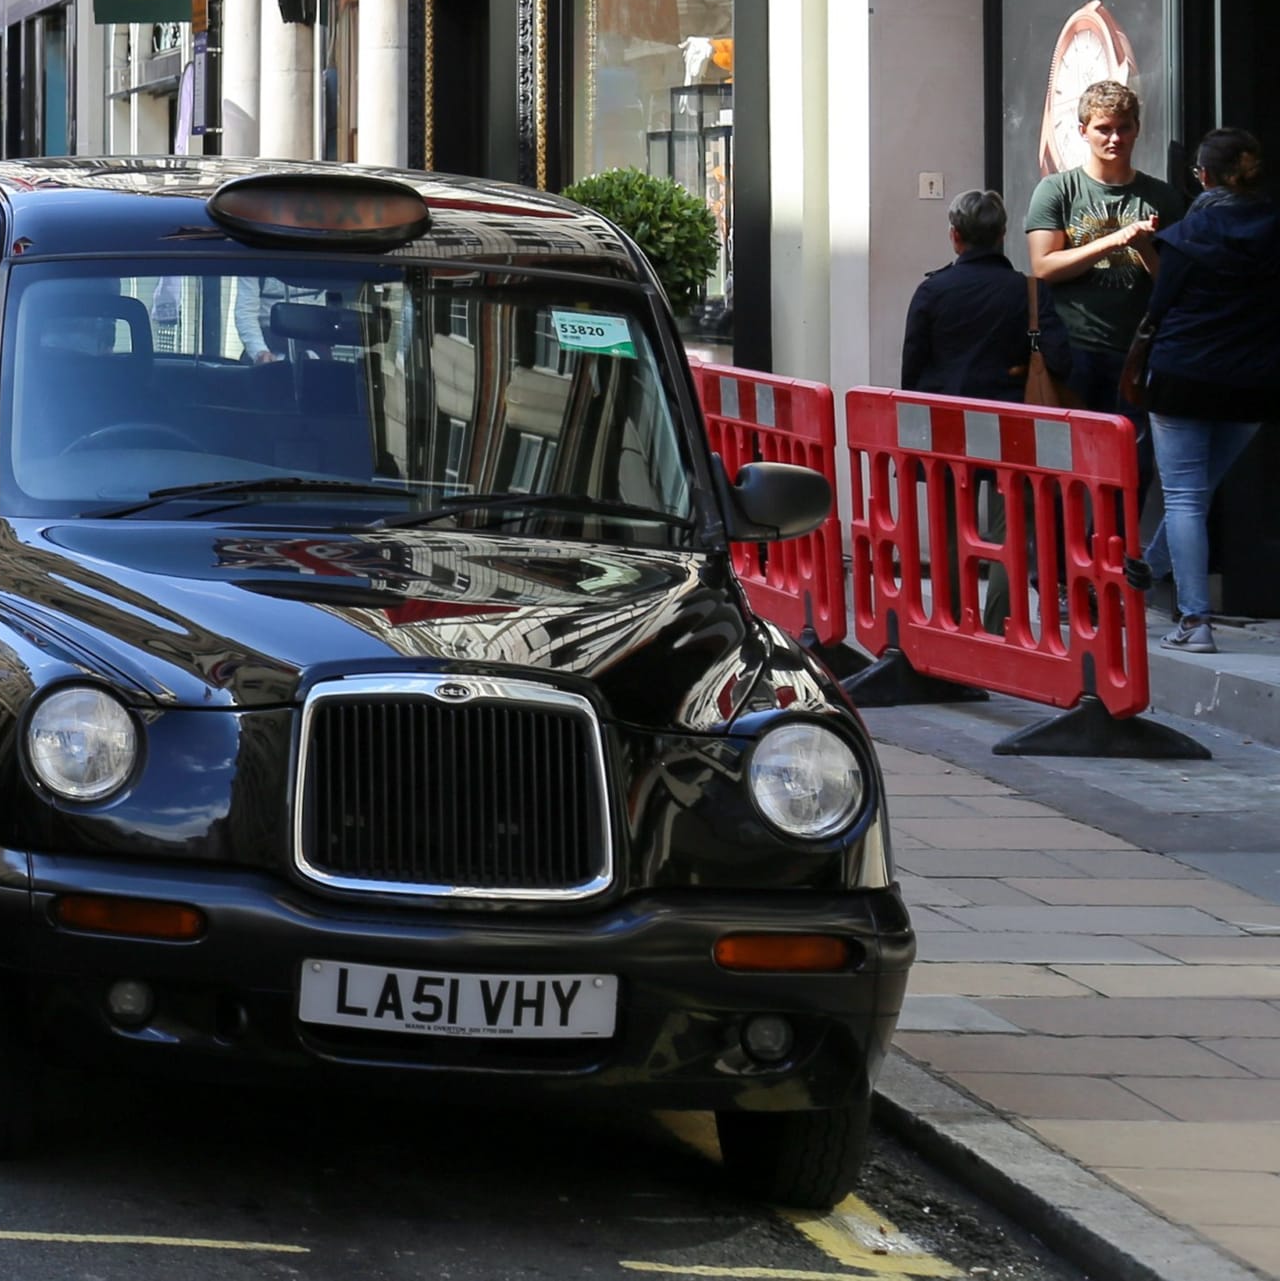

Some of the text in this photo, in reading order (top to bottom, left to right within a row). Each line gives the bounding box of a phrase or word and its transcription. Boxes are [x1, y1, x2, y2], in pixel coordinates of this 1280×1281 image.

[265, 193, 385, 225] TAXI
[561, 324, 604, 337] 53820
[336, 967, 582, 1027] LA51 VHY
